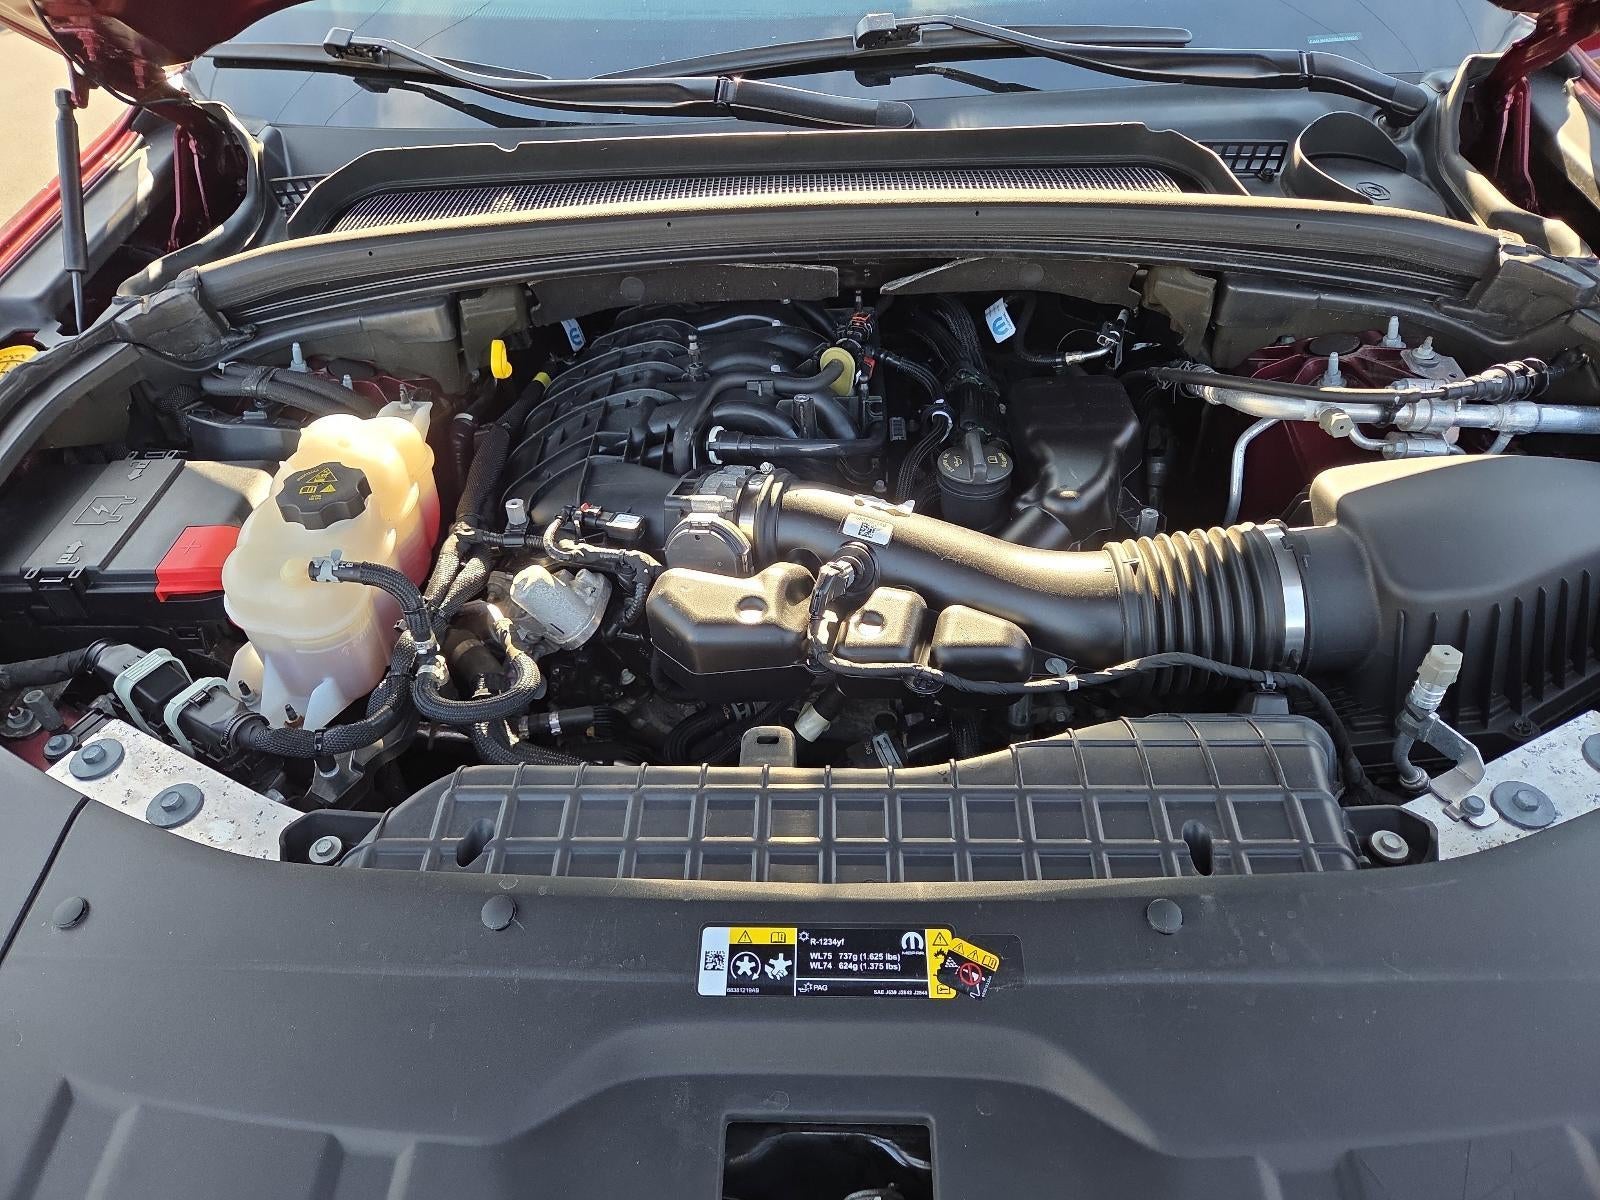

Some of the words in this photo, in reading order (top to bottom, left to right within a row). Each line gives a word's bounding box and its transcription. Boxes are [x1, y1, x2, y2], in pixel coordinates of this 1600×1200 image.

[810, 938, 845, 947] R-1234yf
[809, 952, 833, 960] WL75
[838, 952, 858, 961] 737g
[859, 952, 884, 961] (1.625
[885, 952, 901, 961] lbs)
[809, 961, 833, 969] WL74
[838, 961, 858, 971] 624g
[859, 962, 884, 971] (1.375
[885, 962, 901, 971] lbs)
